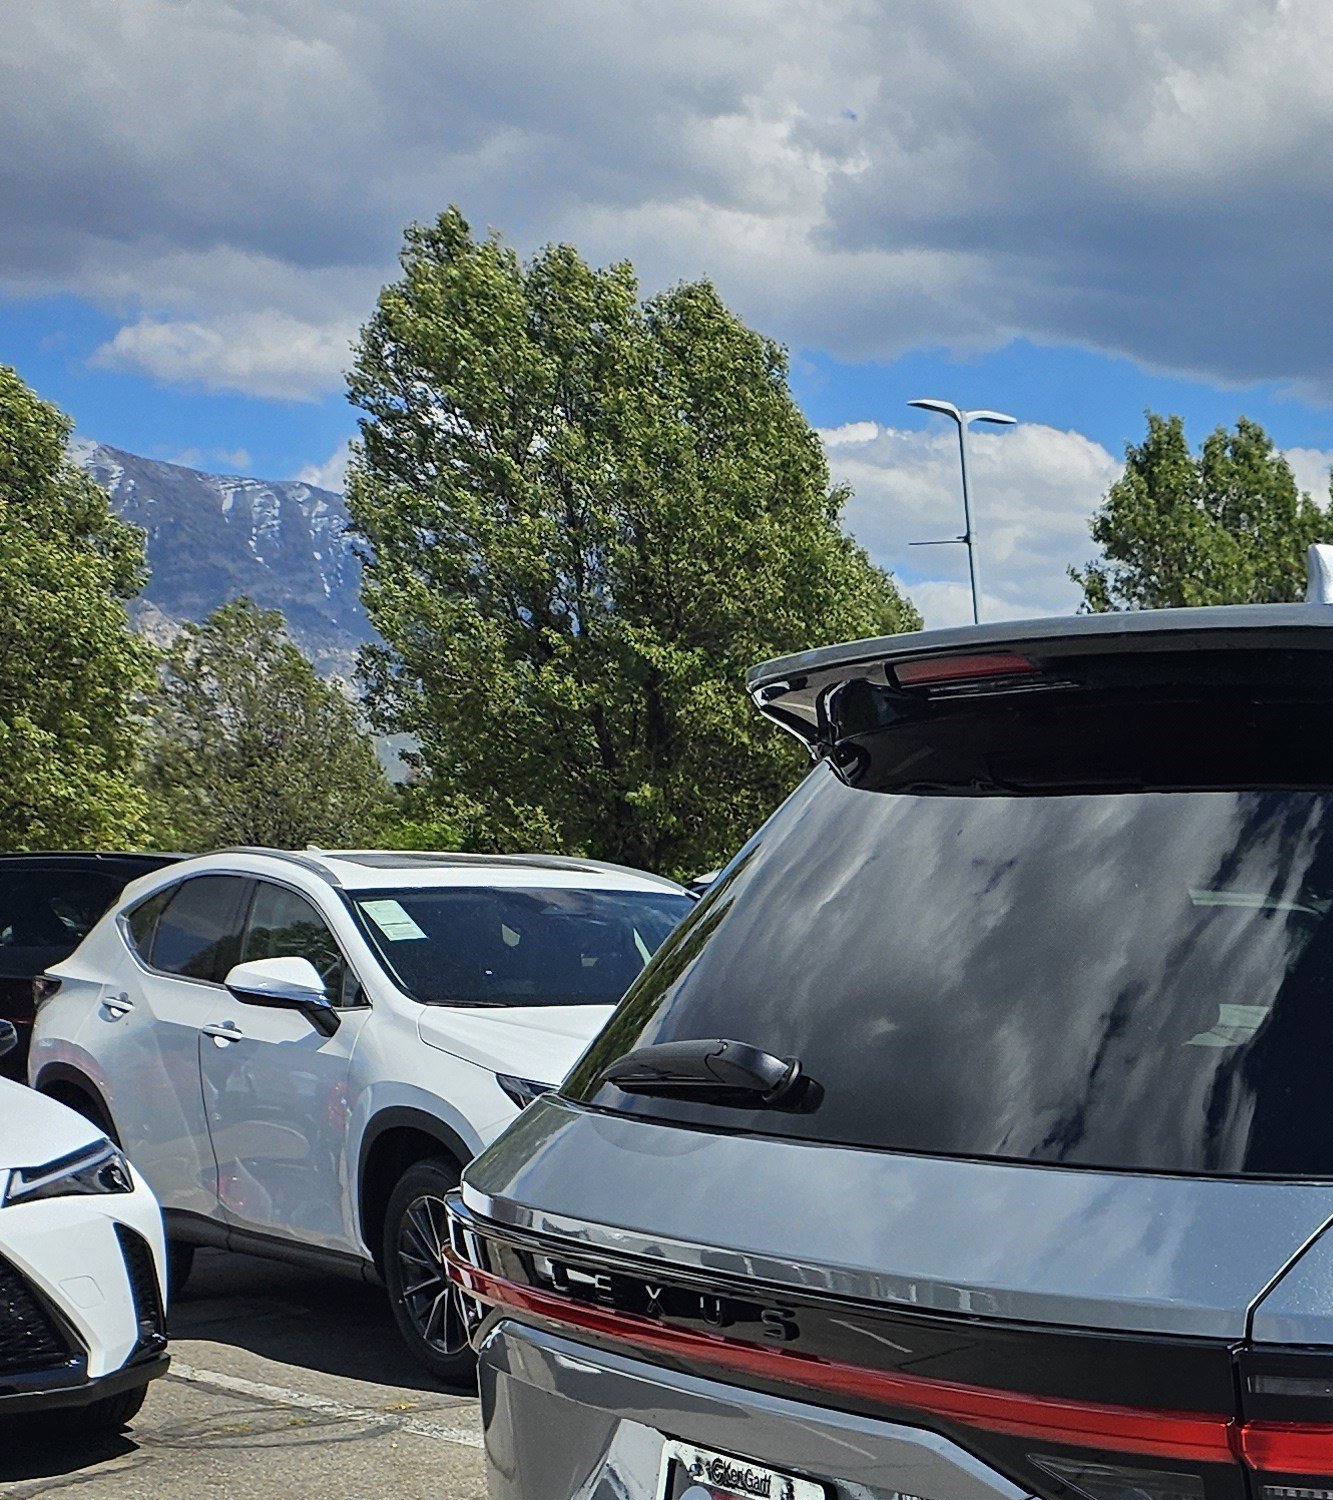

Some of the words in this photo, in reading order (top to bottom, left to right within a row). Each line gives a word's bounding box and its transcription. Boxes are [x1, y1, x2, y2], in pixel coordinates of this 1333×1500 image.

[545, 1256, 799, 1341] LEXUS
[724, 1460, 744, 1486] Ken
[744, 1468, 771, 1496] Garff
